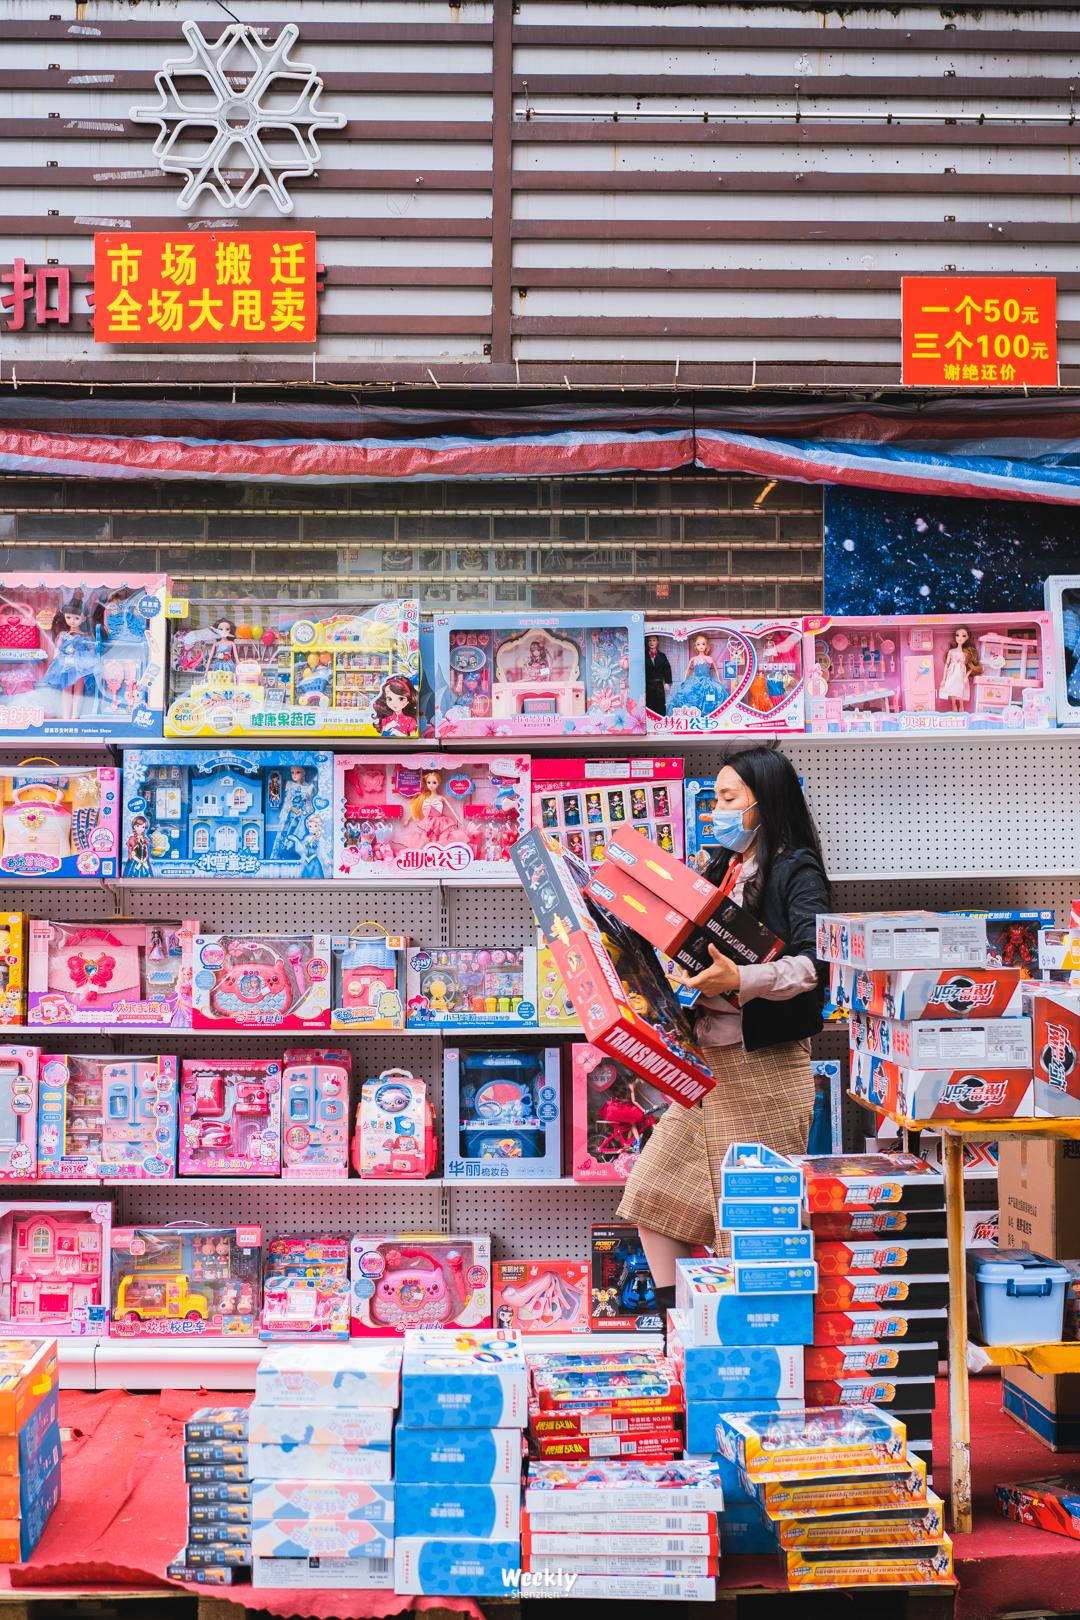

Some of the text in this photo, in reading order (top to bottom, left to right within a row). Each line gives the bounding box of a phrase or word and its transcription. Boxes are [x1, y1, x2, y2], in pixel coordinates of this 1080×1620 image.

[107, 242, 305, 286] 市场搬迁
[107, 288, 305, 332] 全场大甩卖
[921, 295, 1040, 326] 一个50元
[911, 331, 1049, 361] 三个100元
[943, 364, 1017, 381] 谢绝还价
[251, 712, 316, 727] 健康果蔬店
[654, 716, 718, 730] 梦幻公主
[397, 848, 473, 871] 甜心公主
[603, 1026, 708, 1101] TRANSMUTATION
[145, 1320, 206, 1334] 欢乐校巴车
